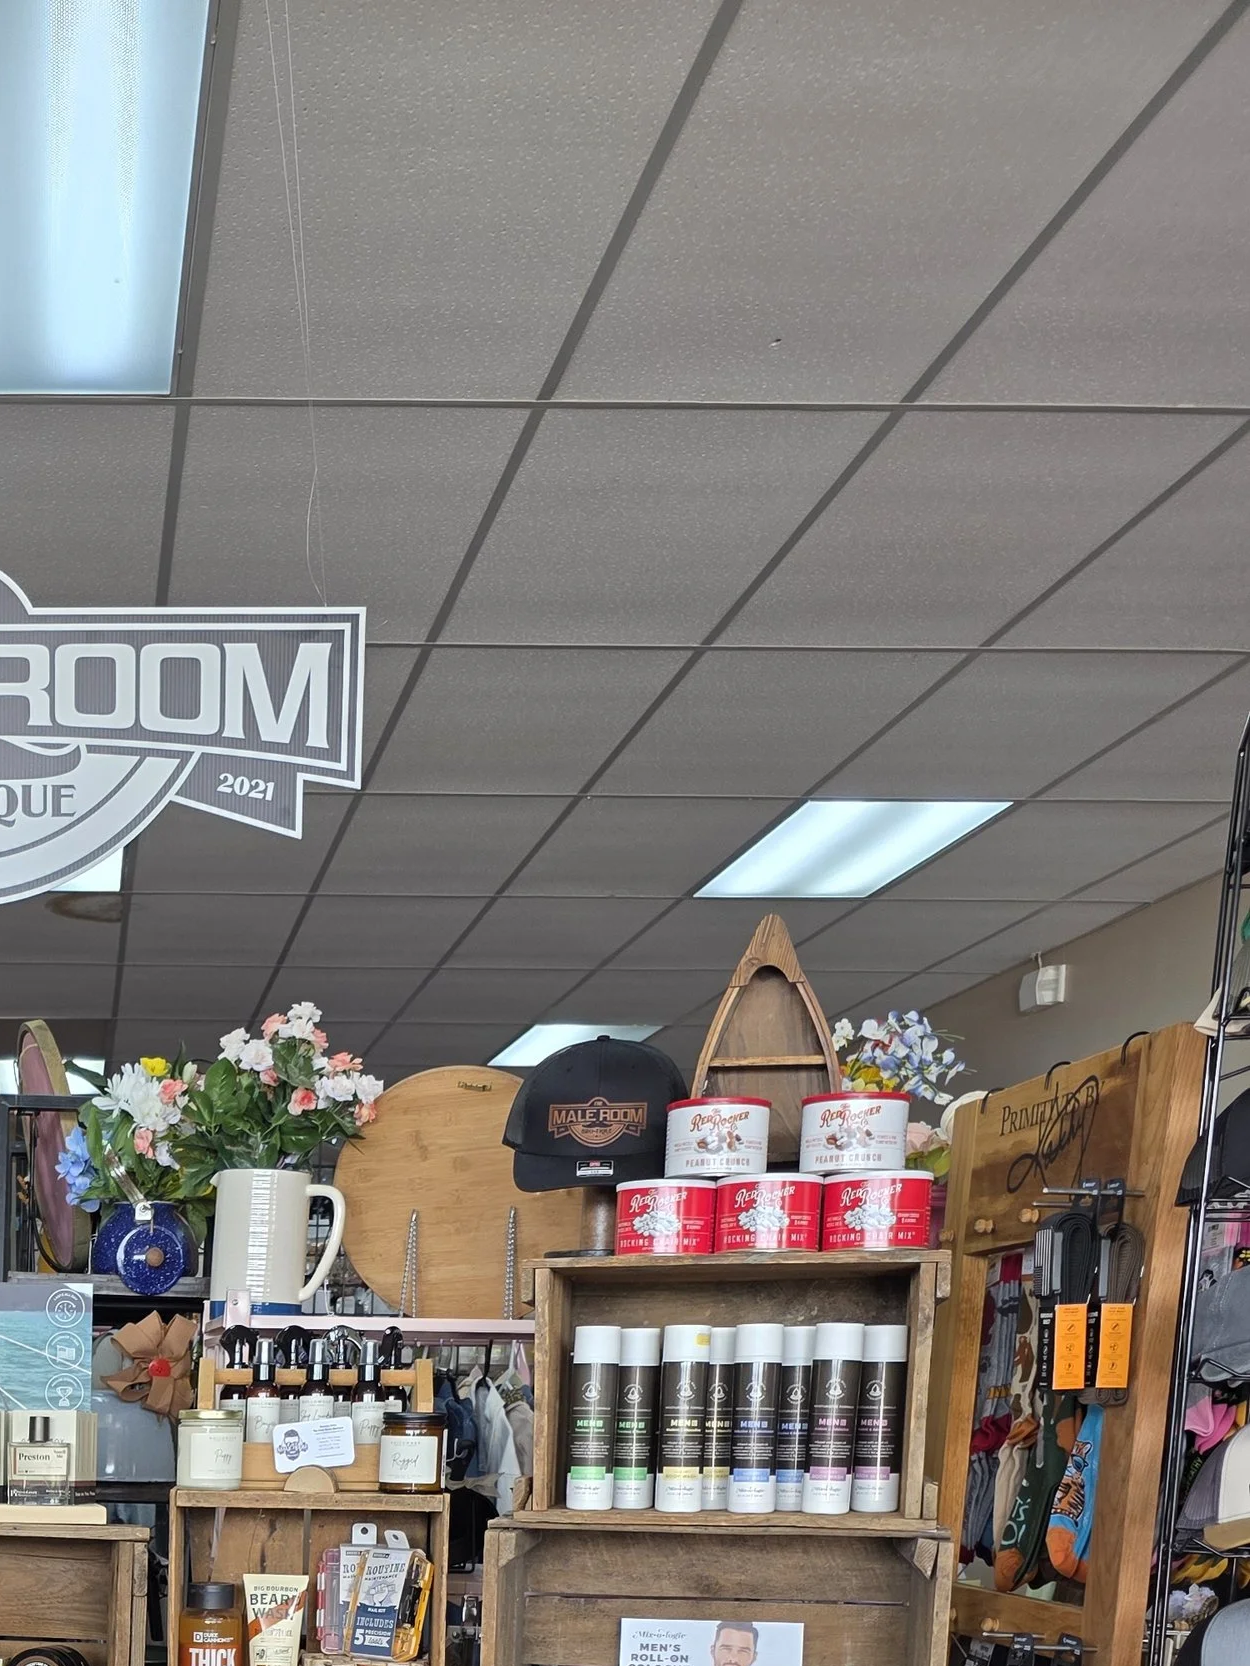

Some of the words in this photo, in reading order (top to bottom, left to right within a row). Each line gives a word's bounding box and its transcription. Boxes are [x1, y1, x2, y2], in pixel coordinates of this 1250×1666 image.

[217, 772, 276, 802] 2021
[553, 1109, 591, 1124] MALE
[602, 1109, 643, 1123] ROOM
[690, 1113, 712, 1132] RED
[710, 1111, 749, 1130] ROCKER
[820, 1109, 843, 1128] RED
[839, 1106, 882, 1126] ROCKER
[999, 1092, 1080, 1136] PRIMITIVES
[630, 1194, 651, 1212] RED
[649, 1192, 687, 1211] ROCKER
[735, 1190, 758, 1208] RED
[754, 1186, 795, 1205] ROCKER
[840, 1188, 865, 1206] RED
[859, 1184, 903, 1205] ROCKER
[19, 1452, 50, 1460] Preston
[366, 1563, 406, 1575] ROUTINE
[357, 1617, 393, 1629] INCLUDES
[354, 1629, 364, 1645] 5
[640, 1643, 681, 1652] MEN'S
[631, 1654, 689, 1663] ROLL-ON
